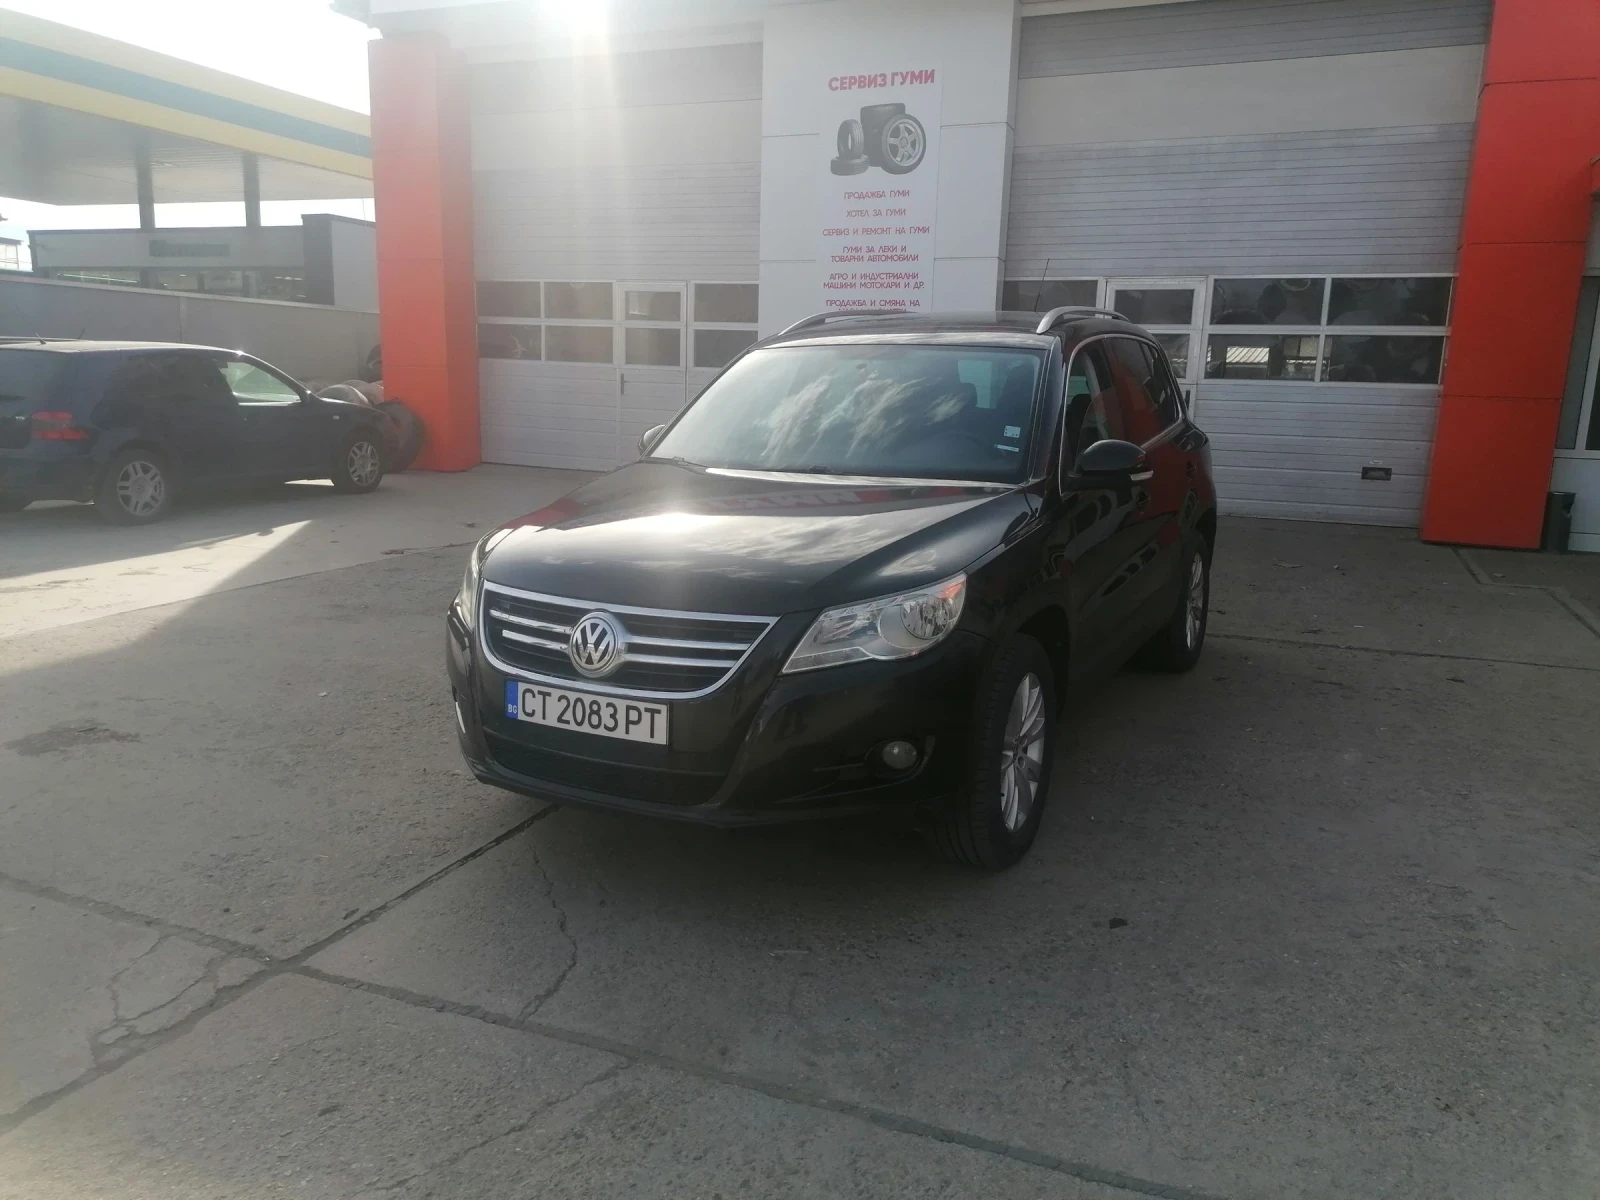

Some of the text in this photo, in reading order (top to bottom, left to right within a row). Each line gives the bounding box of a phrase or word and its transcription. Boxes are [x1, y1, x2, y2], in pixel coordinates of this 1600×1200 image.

[828, 69, 936, 91] СЕРВИЗ ГУМИ
[844, 189, 910, 200] ПРОДАЖБА ГУМИ
[846, 208, 906, 218] ХОТЕЛ ЗА ГУМИ
[822, 226, 930, 237] СЕРВИЗ И РЕМОНТ НА ГУМИ
[866, 245, 875, 253] ЗА
[878, 245, 898, 253] ЛЕКИ
[900, 245, 907, 253] И
[831, 254, 919, 263] ТОВАРНИ АВТОМОБИЛИ
[860, 272, 919, 281] ИНДУСТРИАЛНИ
[860, 281, 901, 289] МОТОКАРИ
[904, 281, 910, 289] И
[913, 281, 925, 290] ДР.
[909, 299, 921, 307] НА
[507, 703, 518, 714] BG
[521, 688, 662, 739] CT 2083 PT
